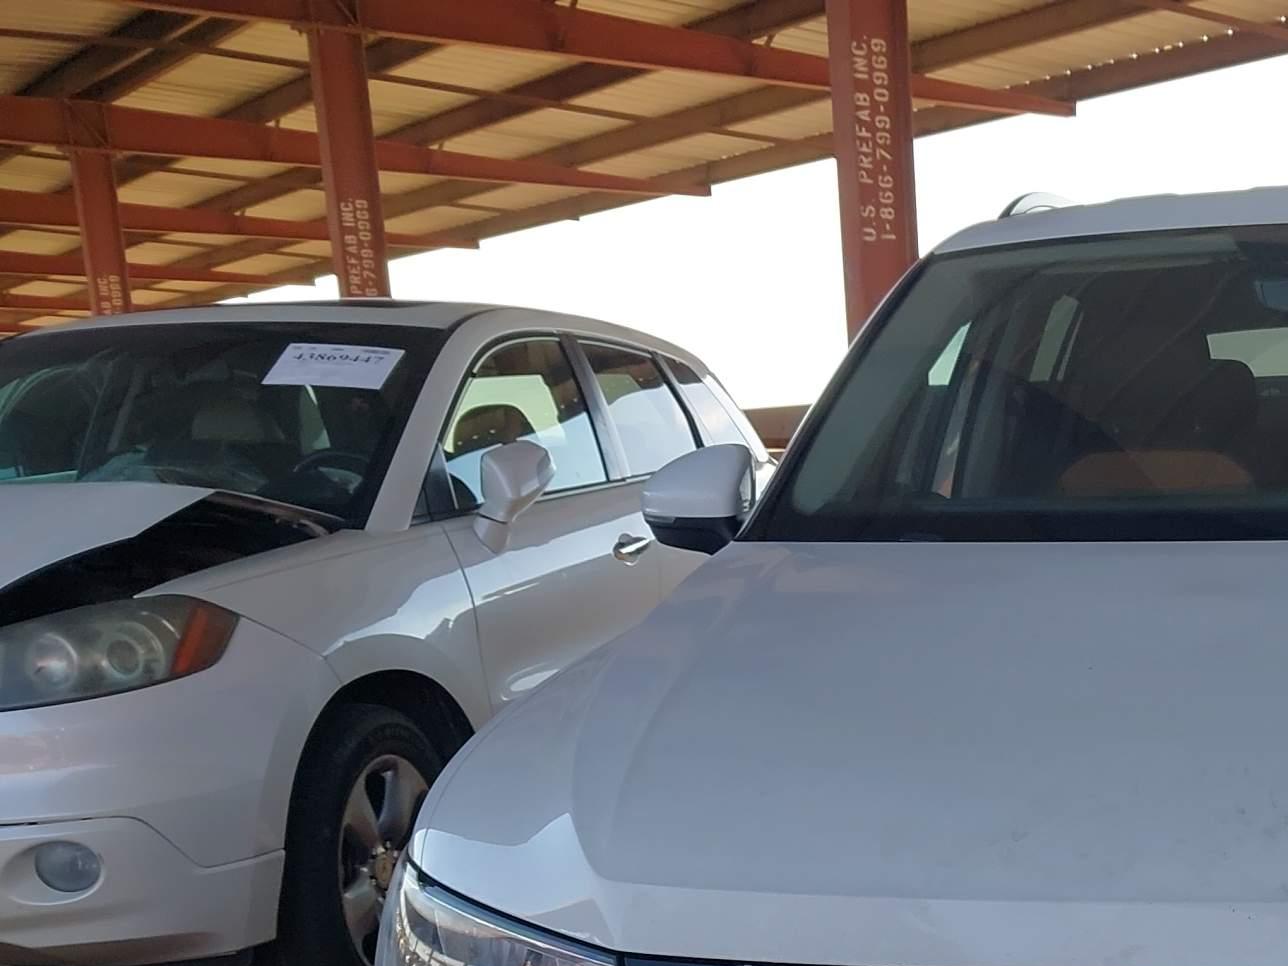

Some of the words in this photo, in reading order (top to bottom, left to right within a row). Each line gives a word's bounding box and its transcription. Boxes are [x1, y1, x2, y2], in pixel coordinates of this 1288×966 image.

[850, 35, 869, 80] INC.
[853, 92, 874, 184] PREFAB
[344, 234, 363, 295] PREFAB
